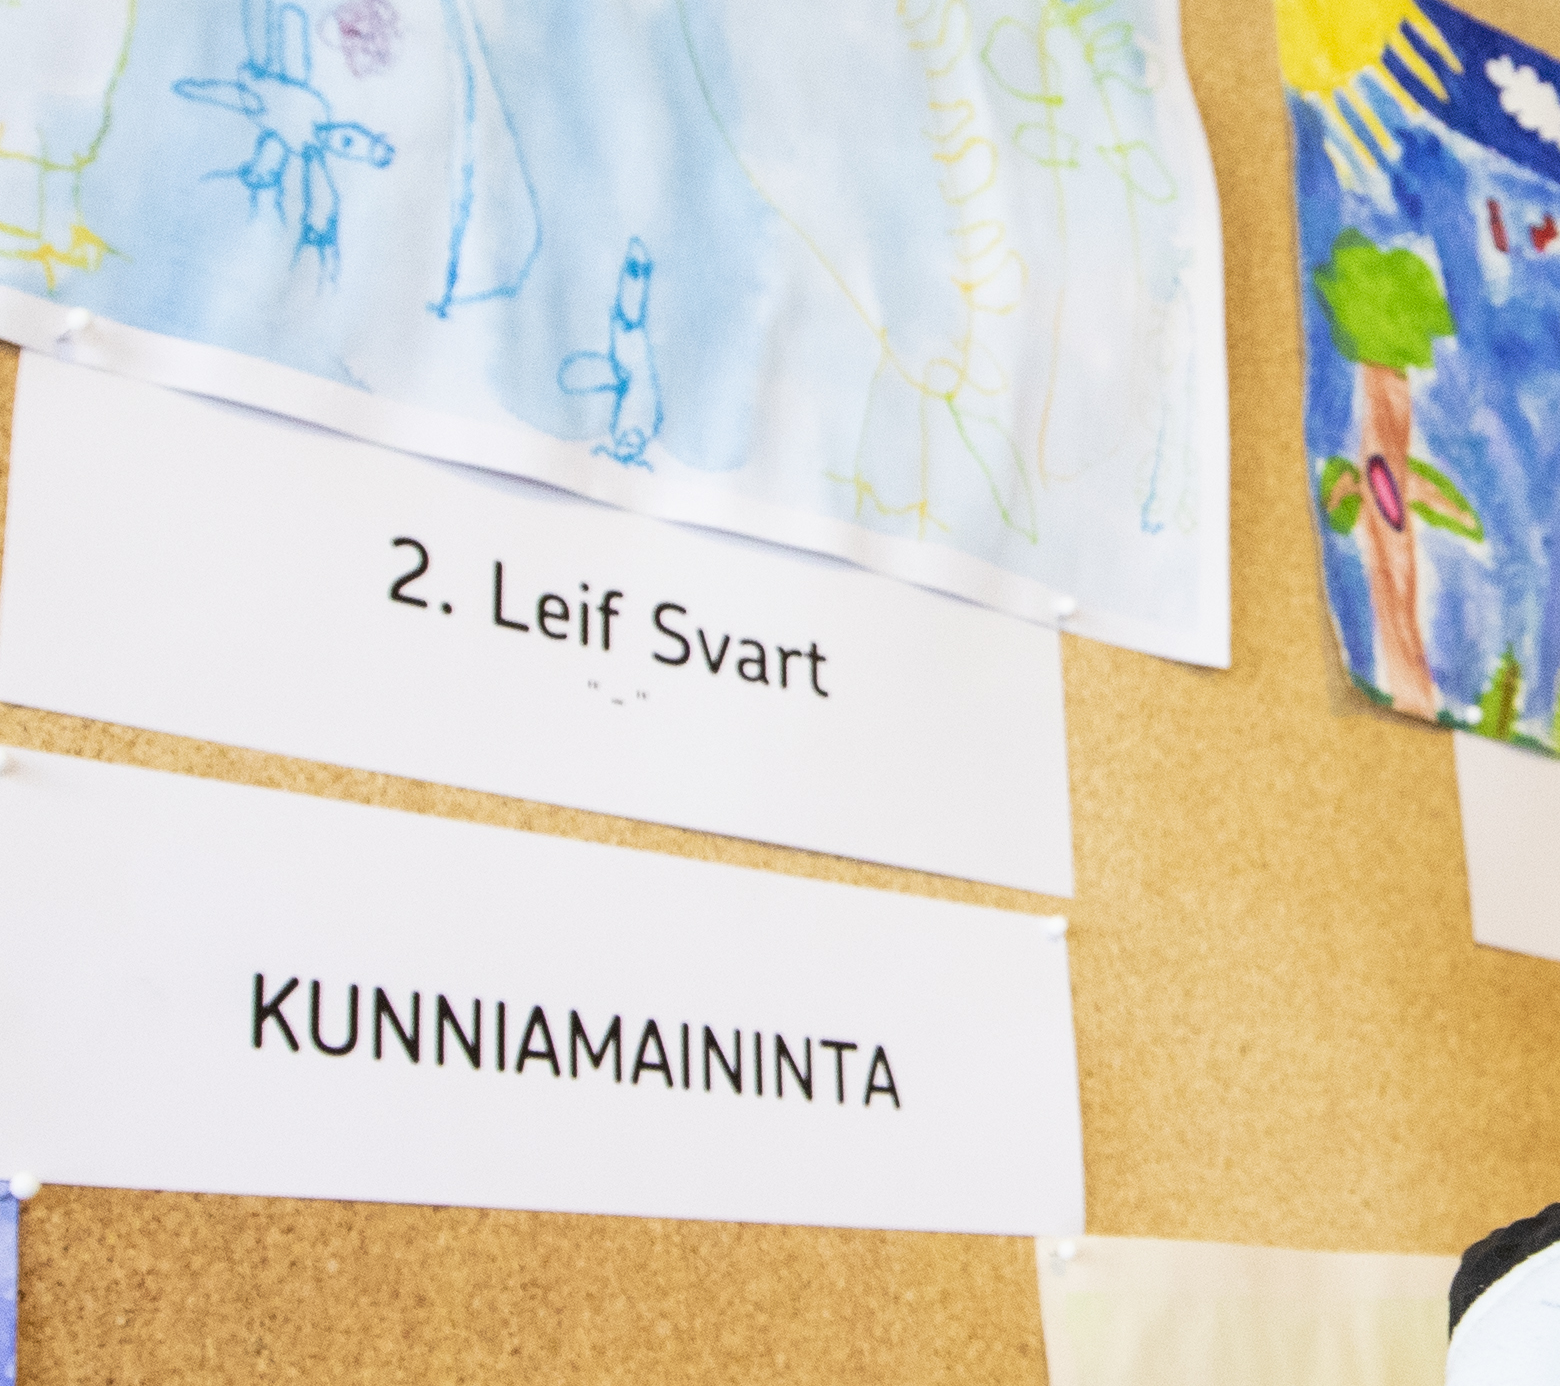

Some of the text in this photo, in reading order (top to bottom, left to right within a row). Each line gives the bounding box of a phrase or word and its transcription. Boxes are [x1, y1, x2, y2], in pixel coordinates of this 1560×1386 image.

[388, 537, 831, 699] 2. Leif Svart
[248, 972, 904, 1112] KUNNIAMAININTA
